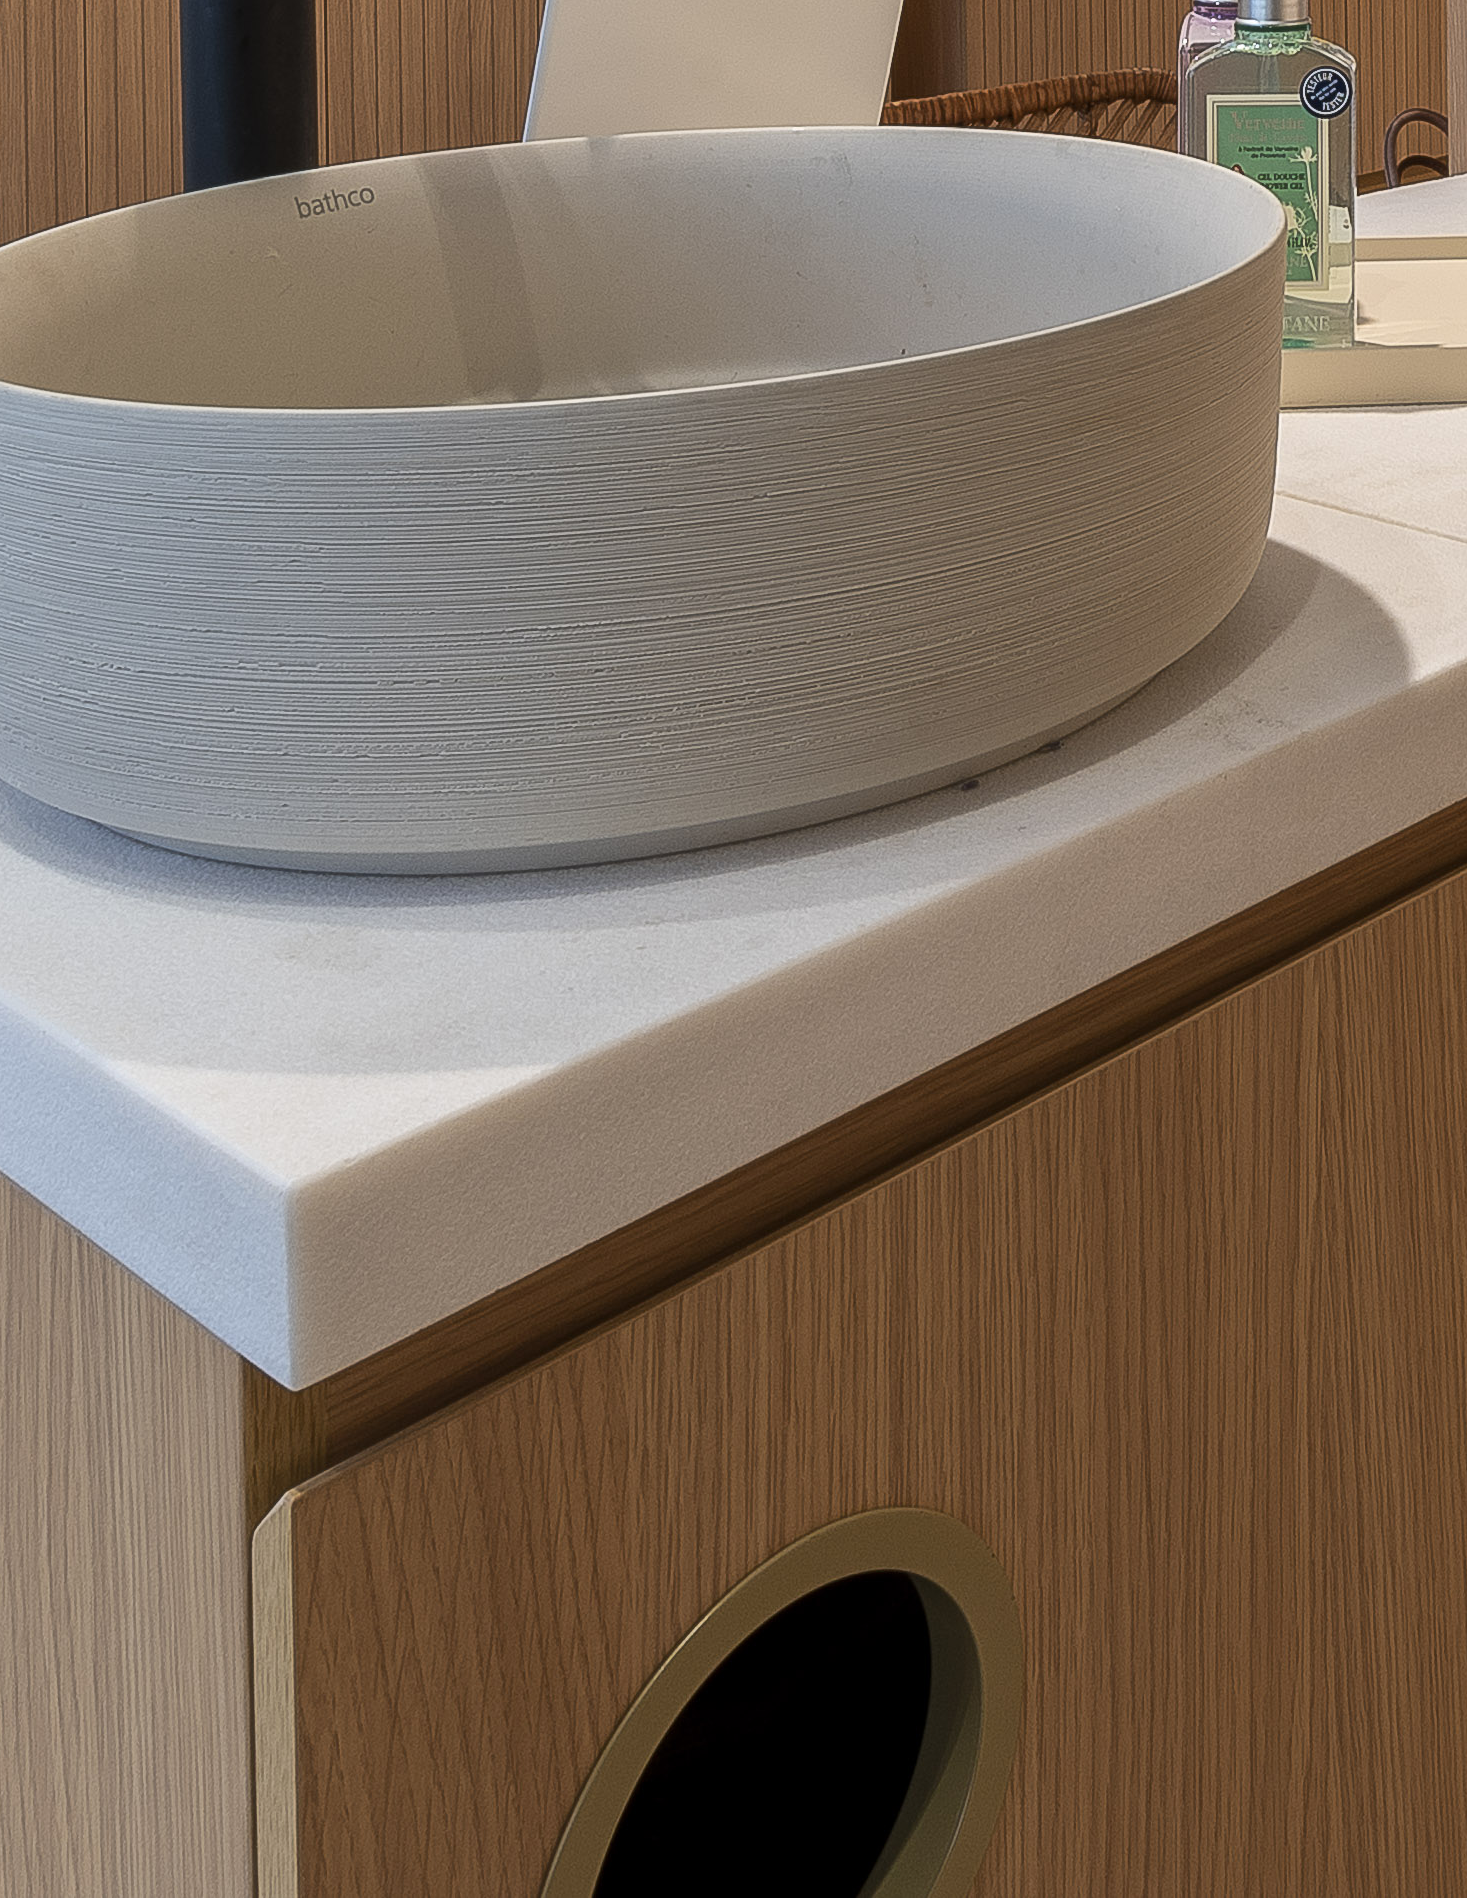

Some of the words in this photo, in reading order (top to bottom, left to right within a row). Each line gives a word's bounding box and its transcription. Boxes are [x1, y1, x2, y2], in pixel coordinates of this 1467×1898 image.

[1306, 71, 1334, 95] TESTEUR
[1322, 91, 1346, 112] TESTER
[1257, 173, 1272, 181] GEL
[1274, 173, 1305, 181] DOUCHE
[294, 187, 375, 219] bathco
